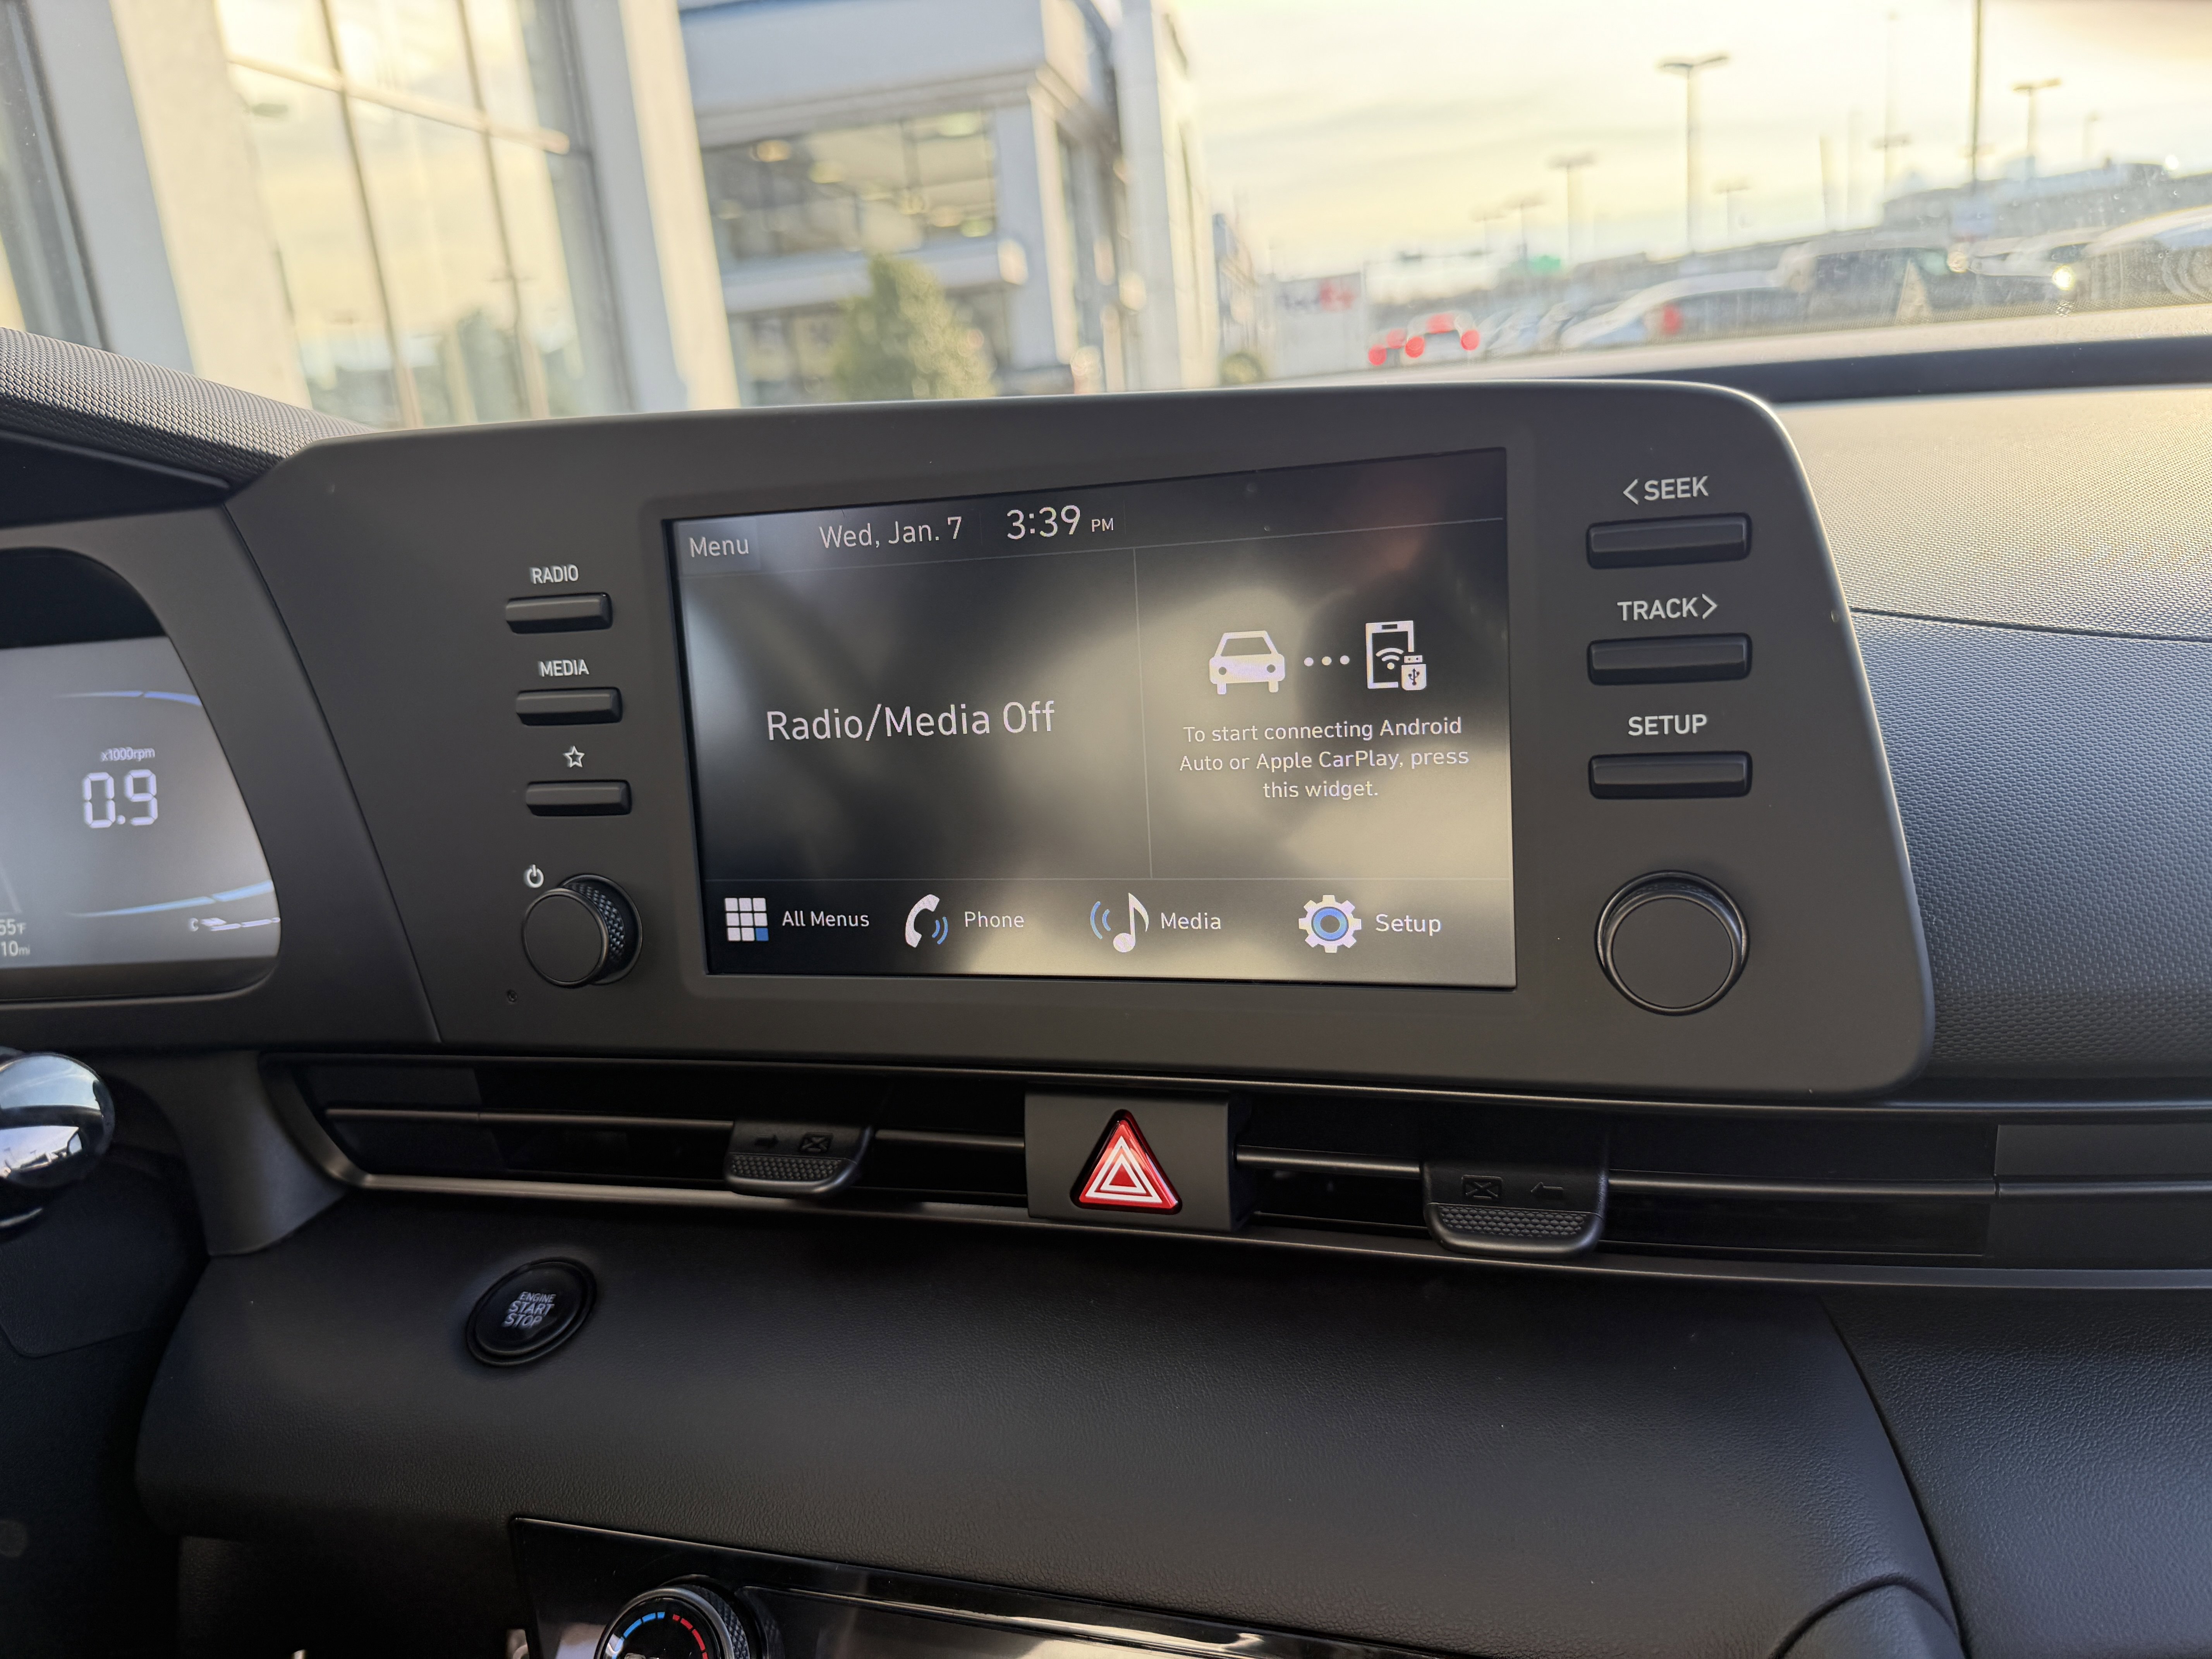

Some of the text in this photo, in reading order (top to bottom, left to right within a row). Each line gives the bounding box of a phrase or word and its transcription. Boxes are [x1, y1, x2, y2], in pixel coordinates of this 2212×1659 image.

[1644, 476, 1709, 501] SEEK
[819, 517, 962, 548] Wed, Jan. 7
[1006, 505, 1114, 540] 3:39 PM
[689, 537, 749, 557] Menu
[530, 565, 579, 584] RADIO
[1617, 597, 1698, 621] TRACK
[539, 659, 589, 677] MEDIA
[766, 701, 1054, 741] Radio/Media Off
[1183, 717, 1462, 742] To start connecting Android
[1628, 714, 1708, 736] SETUP
[1180, 749, 1469, 773] Auto or Apple CarPlay, press
[82, 769, 158, 828] 0.9
[1263, 780, 1379, 800] this widget.
[782, 910, 870, 927] All Menus
[965, 910, 1025, 928] Phone
[1161, 912, 1221, 930] Media
[1375, 914, 1441, 936] Setup
[519, 1291, 556, 1303] ENGINE
[508, 1300, 555, 1316] START
[503, 1313, 543, 1329] STOP
